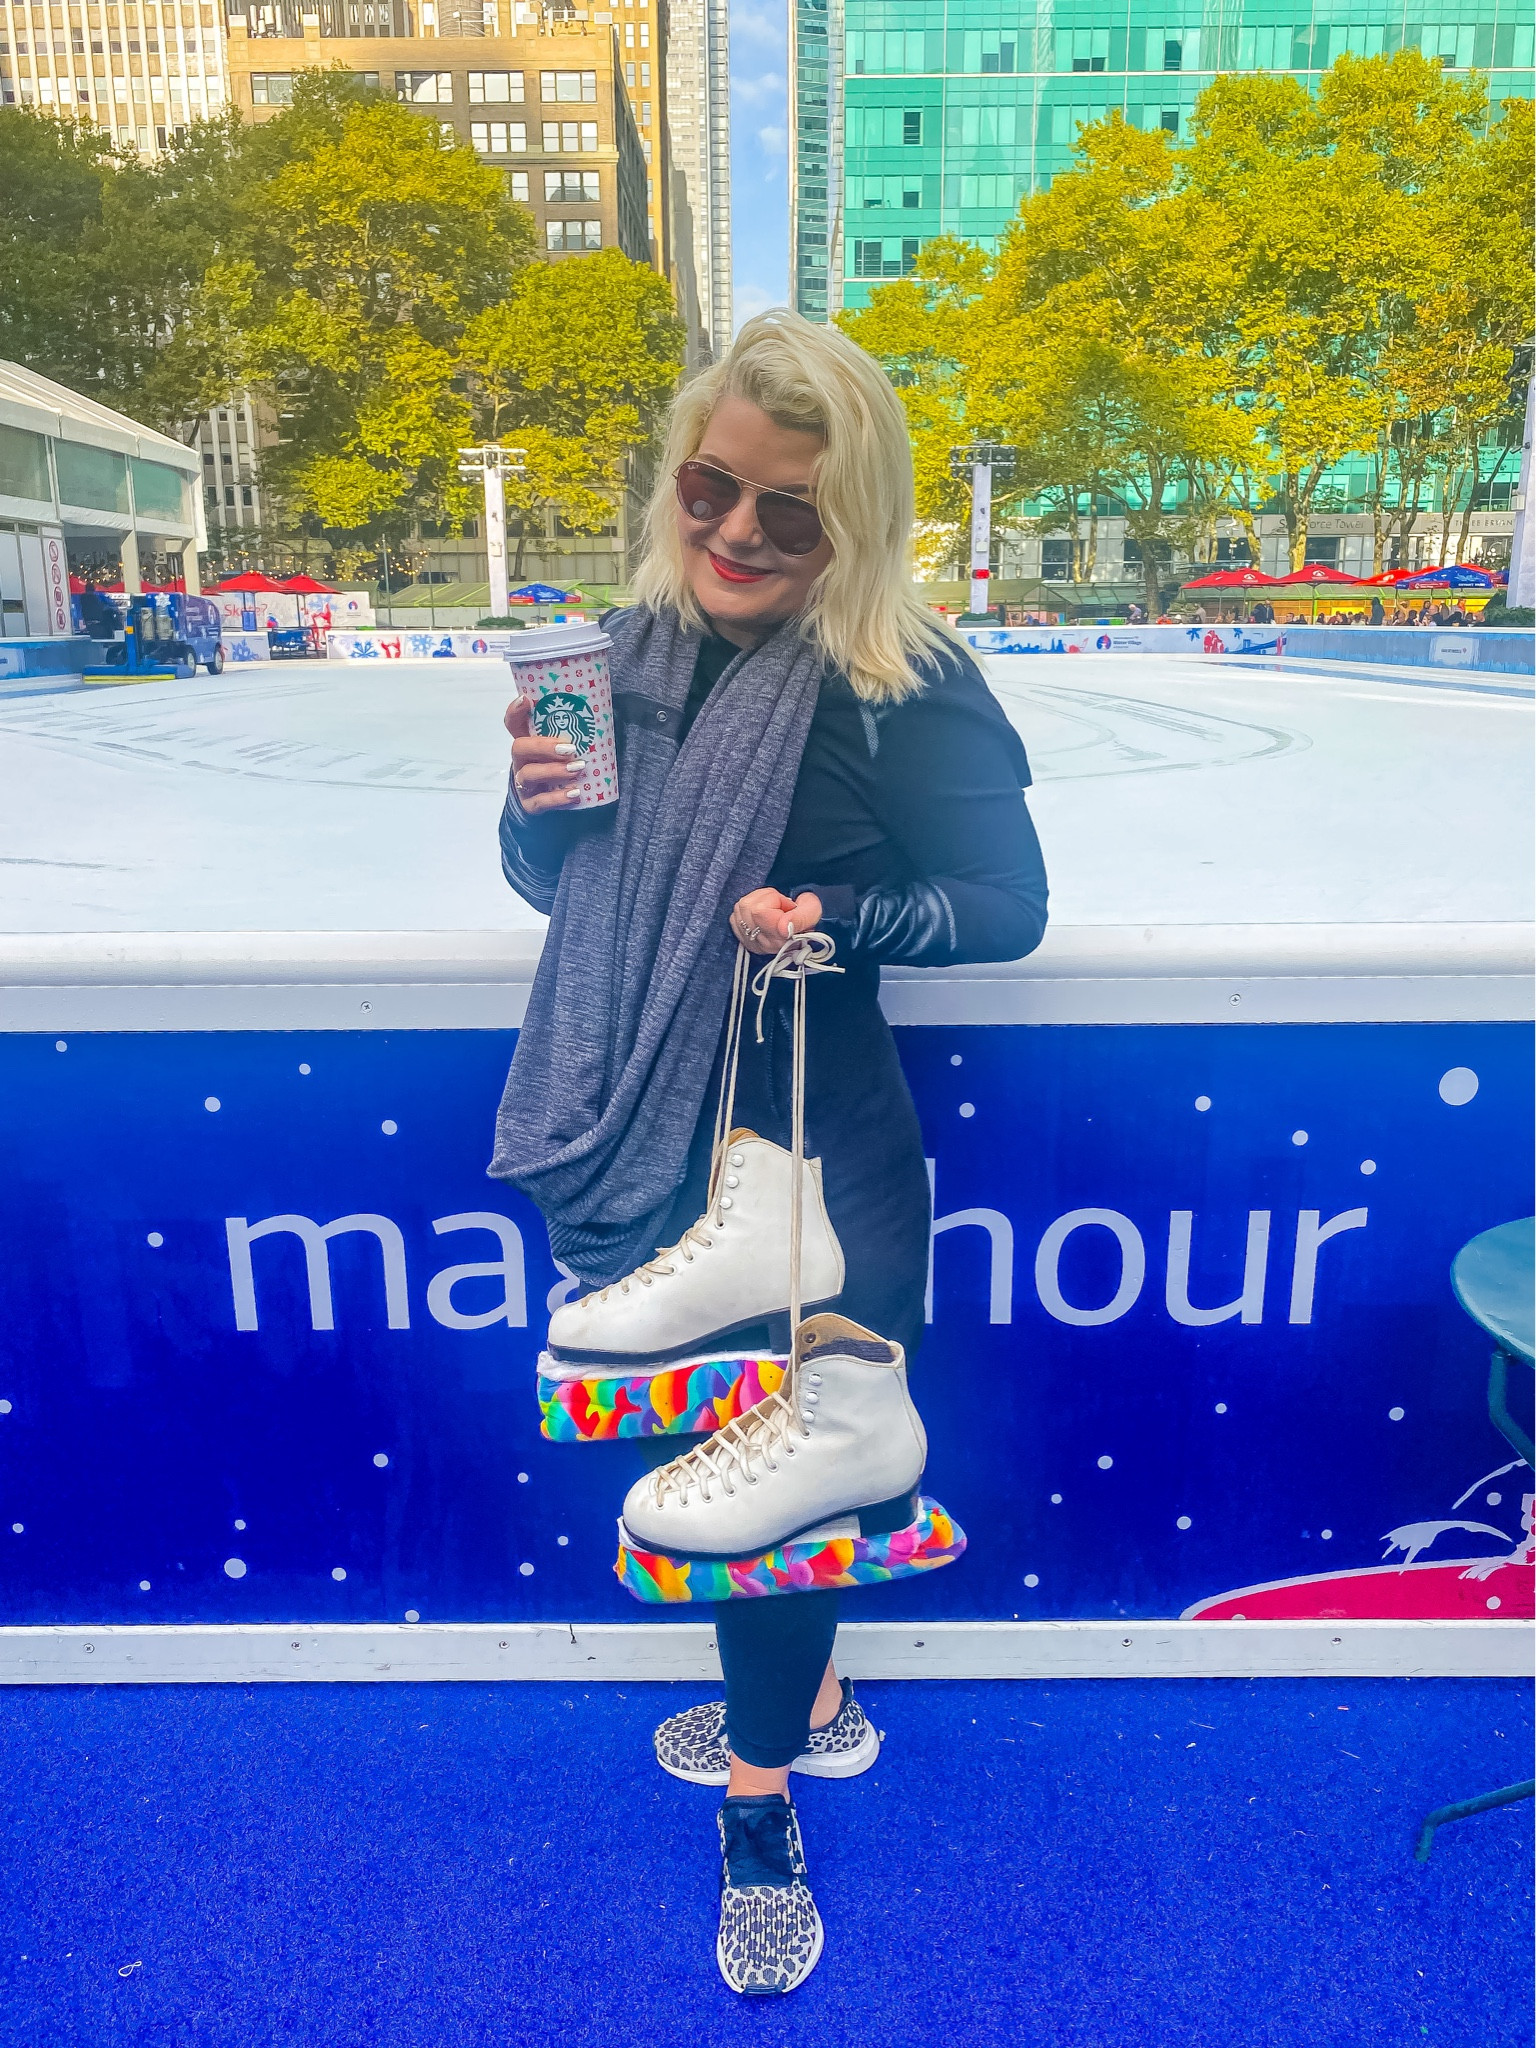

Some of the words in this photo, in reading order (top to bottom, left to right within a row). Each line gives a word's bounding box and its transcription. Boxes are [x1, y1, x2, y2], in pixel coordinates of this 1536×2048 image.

[1279, 519, 1332, 529] Sorce
[1335, 519, 1364, 529] Tower
[1485, 519, 1513, 527] BRYAN
[224, 603, 268, 617] Ske?
[226, 1211, 580, 1332] ma
[924, 1157, 1369, 1327] hour
